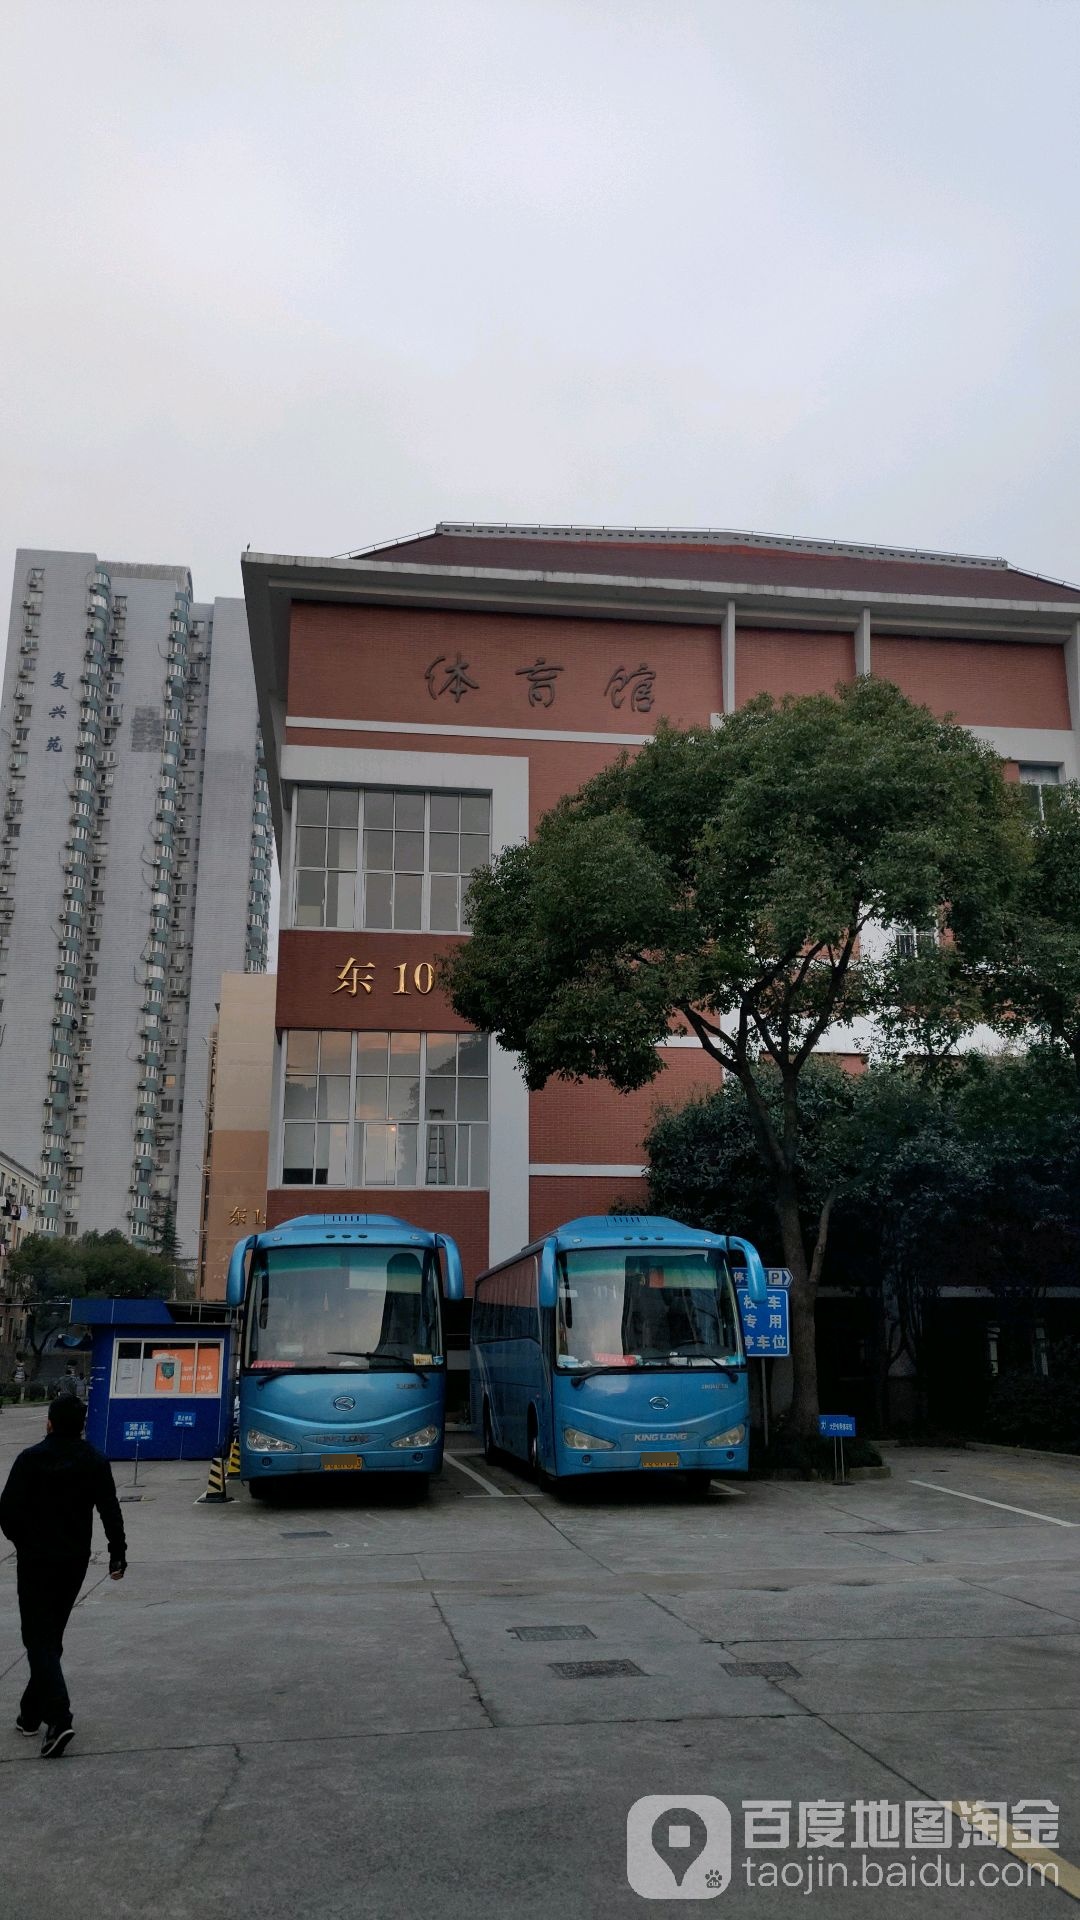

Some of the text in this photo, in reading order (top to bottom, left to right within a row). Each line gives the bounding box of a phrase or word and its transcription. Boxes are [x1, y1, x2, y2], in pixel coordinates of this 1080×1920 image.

[424, 652, 657, 713] 体育馆
[45, 671, 69, 753] 复兴苑
[744, 1314, 782, 1329] 专用
[744, 1334, 787, 1350] 停车位
[634, 1432, 688, 1441] KING LONG
